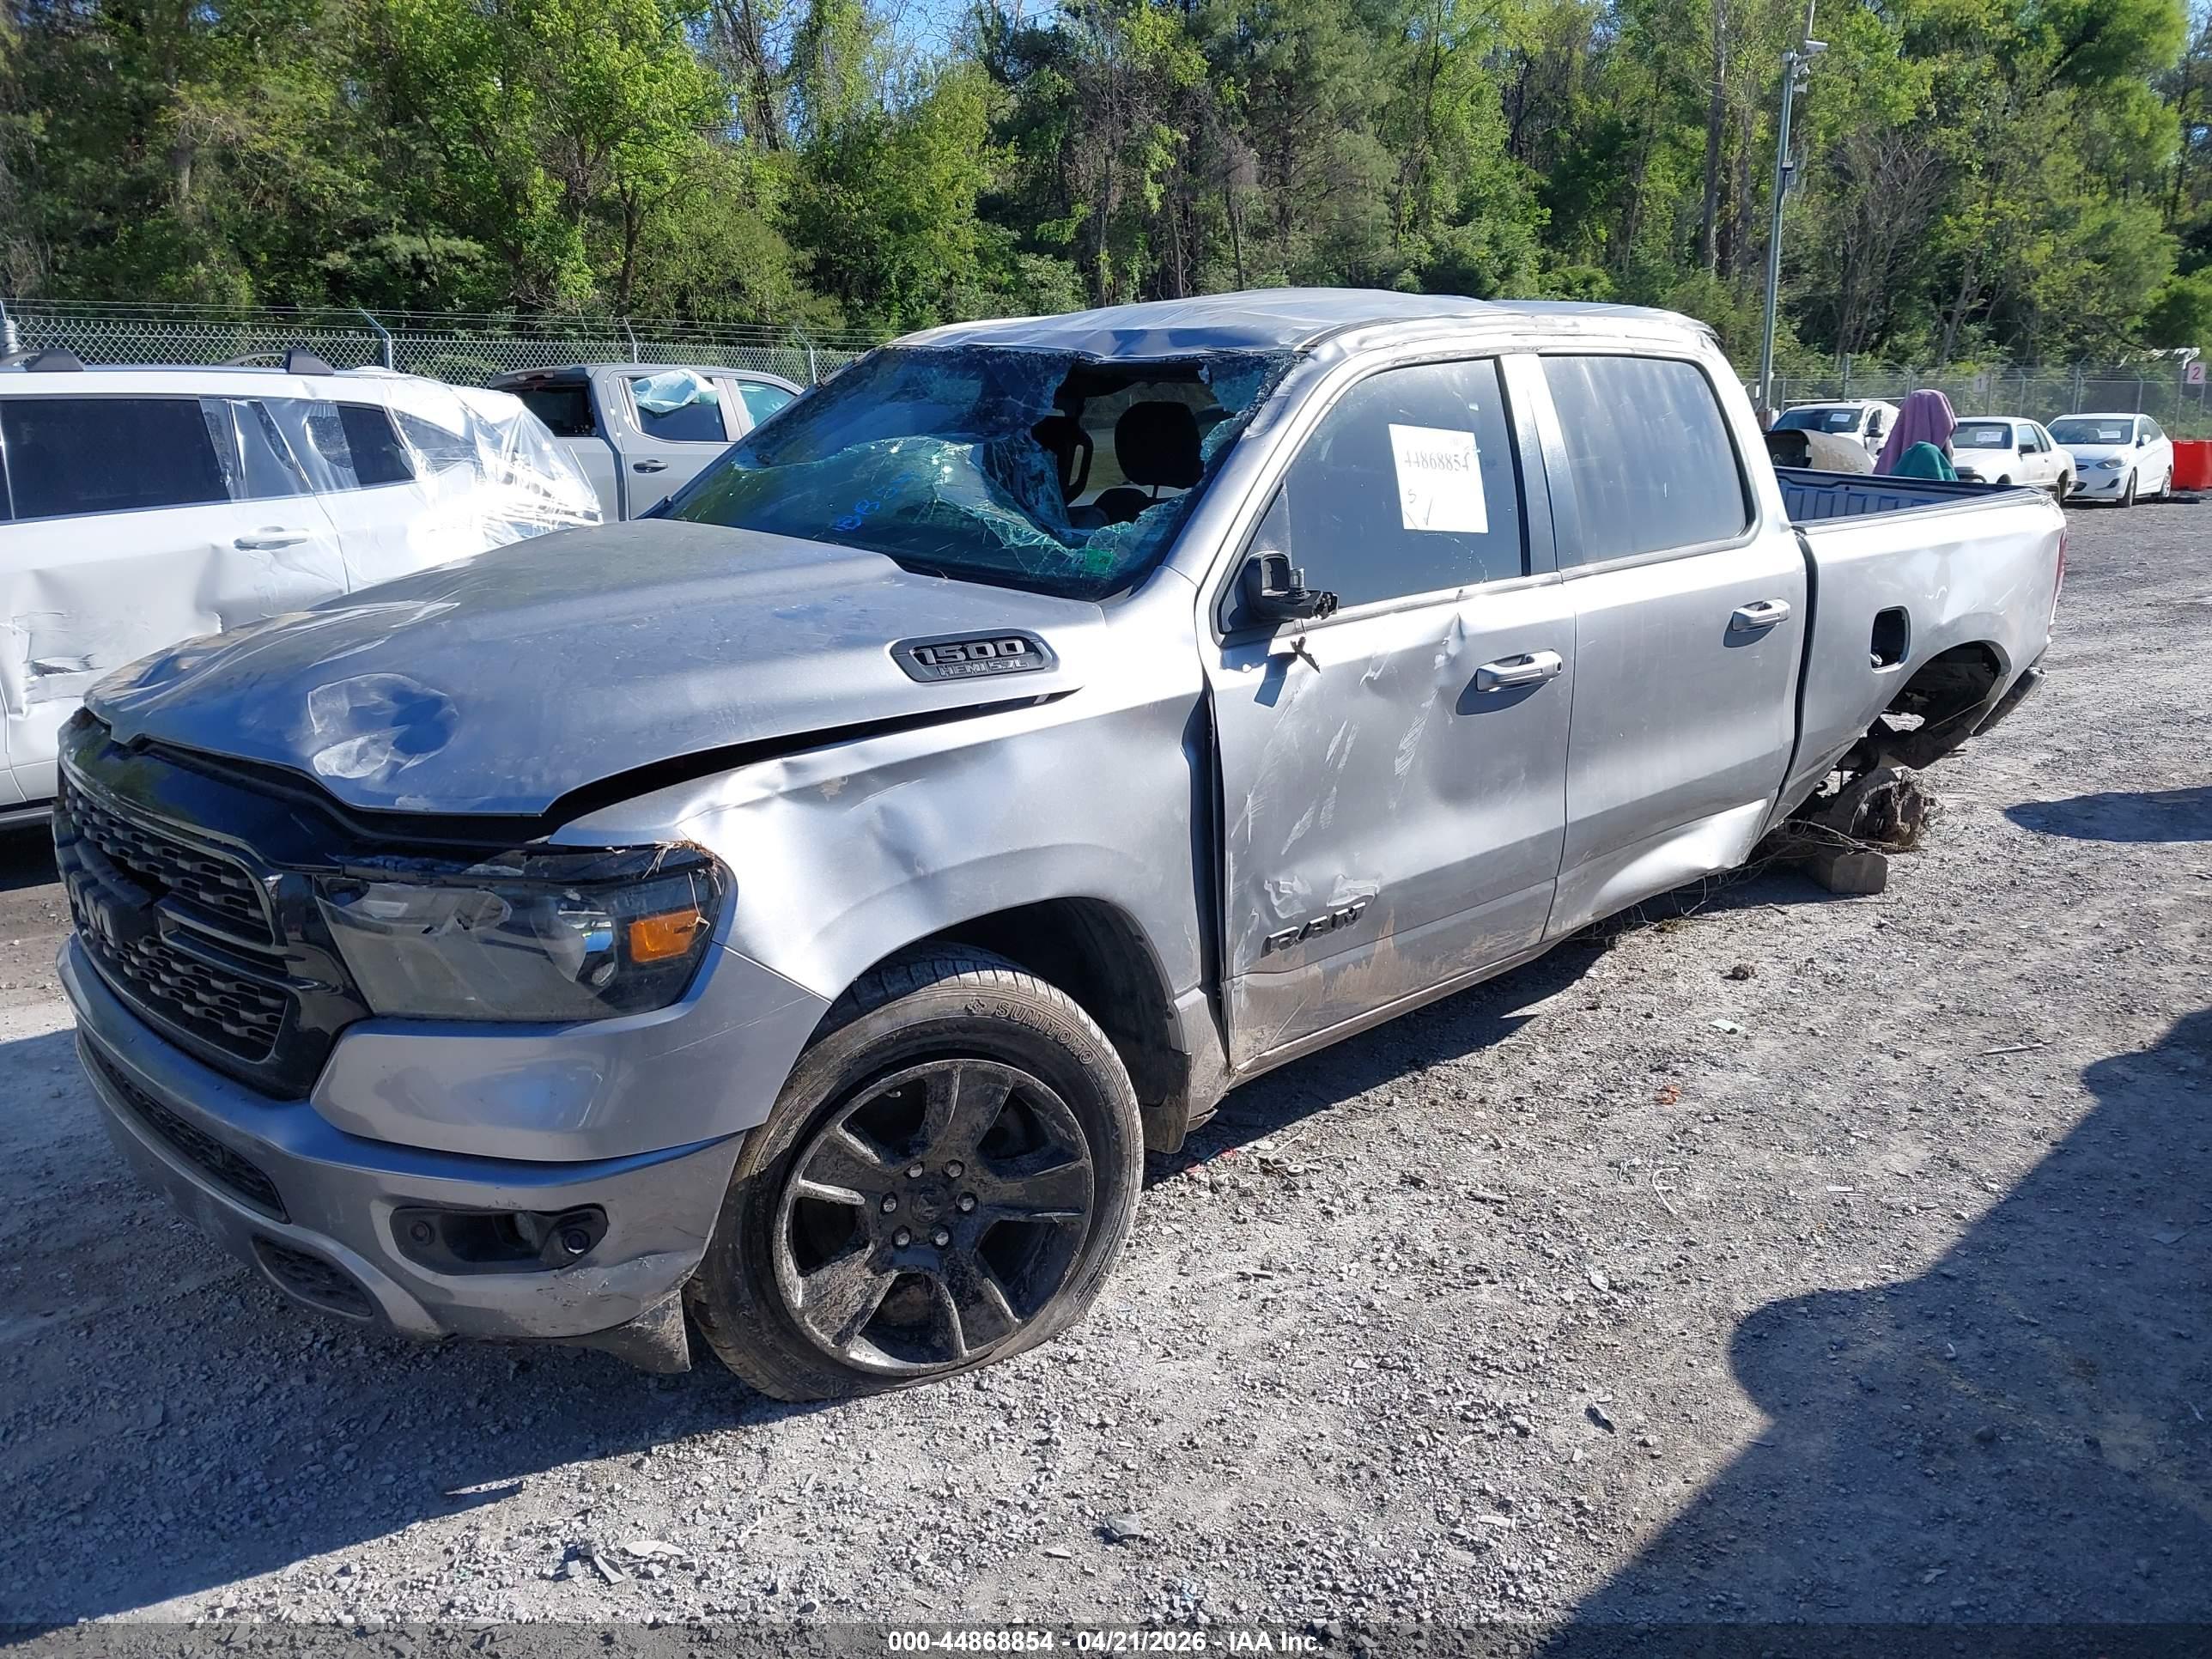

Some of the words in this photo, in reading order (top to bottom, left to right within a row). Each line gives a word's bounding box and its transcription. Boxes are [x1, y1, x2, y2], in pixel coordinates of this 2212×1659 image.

[2192, 367, 2201, 380] 2
[912, 639, 1025, 665] 1500
[938, 664, 987, 677] HEMI
[1261, 901, 1366, 958] RAM
[995, 1000, 1094, 1064] SUMITOMO
